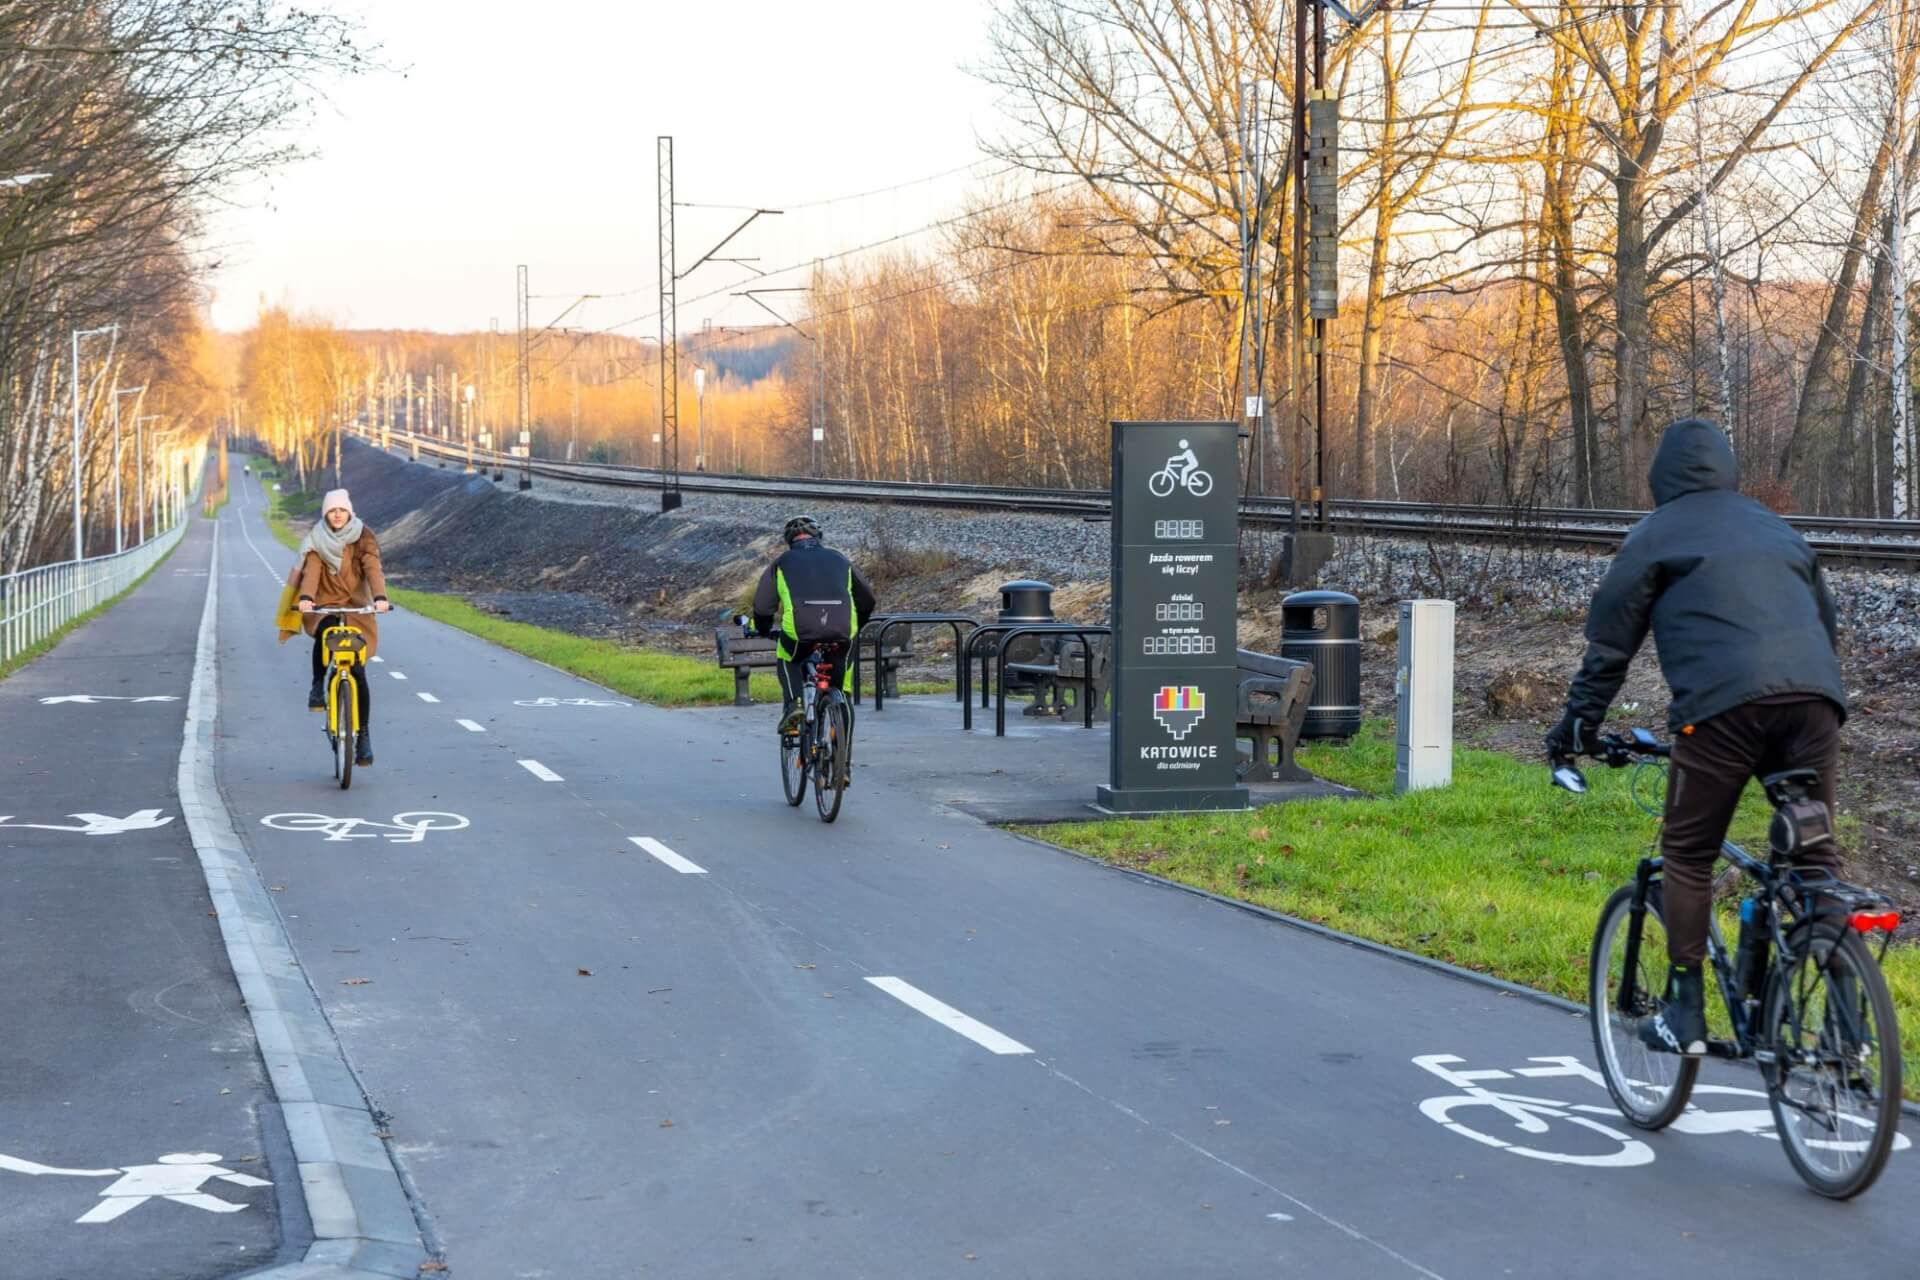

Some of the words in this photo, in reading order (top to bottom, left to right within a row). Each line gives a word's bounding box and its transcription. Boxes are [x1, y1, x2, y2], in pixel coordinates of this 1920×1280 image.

[1149, 553, 1173, 564] Jazda
[1175, 554, 1214, 562] rowerem
[1140, 745, 1217, 759] KATOWICE
